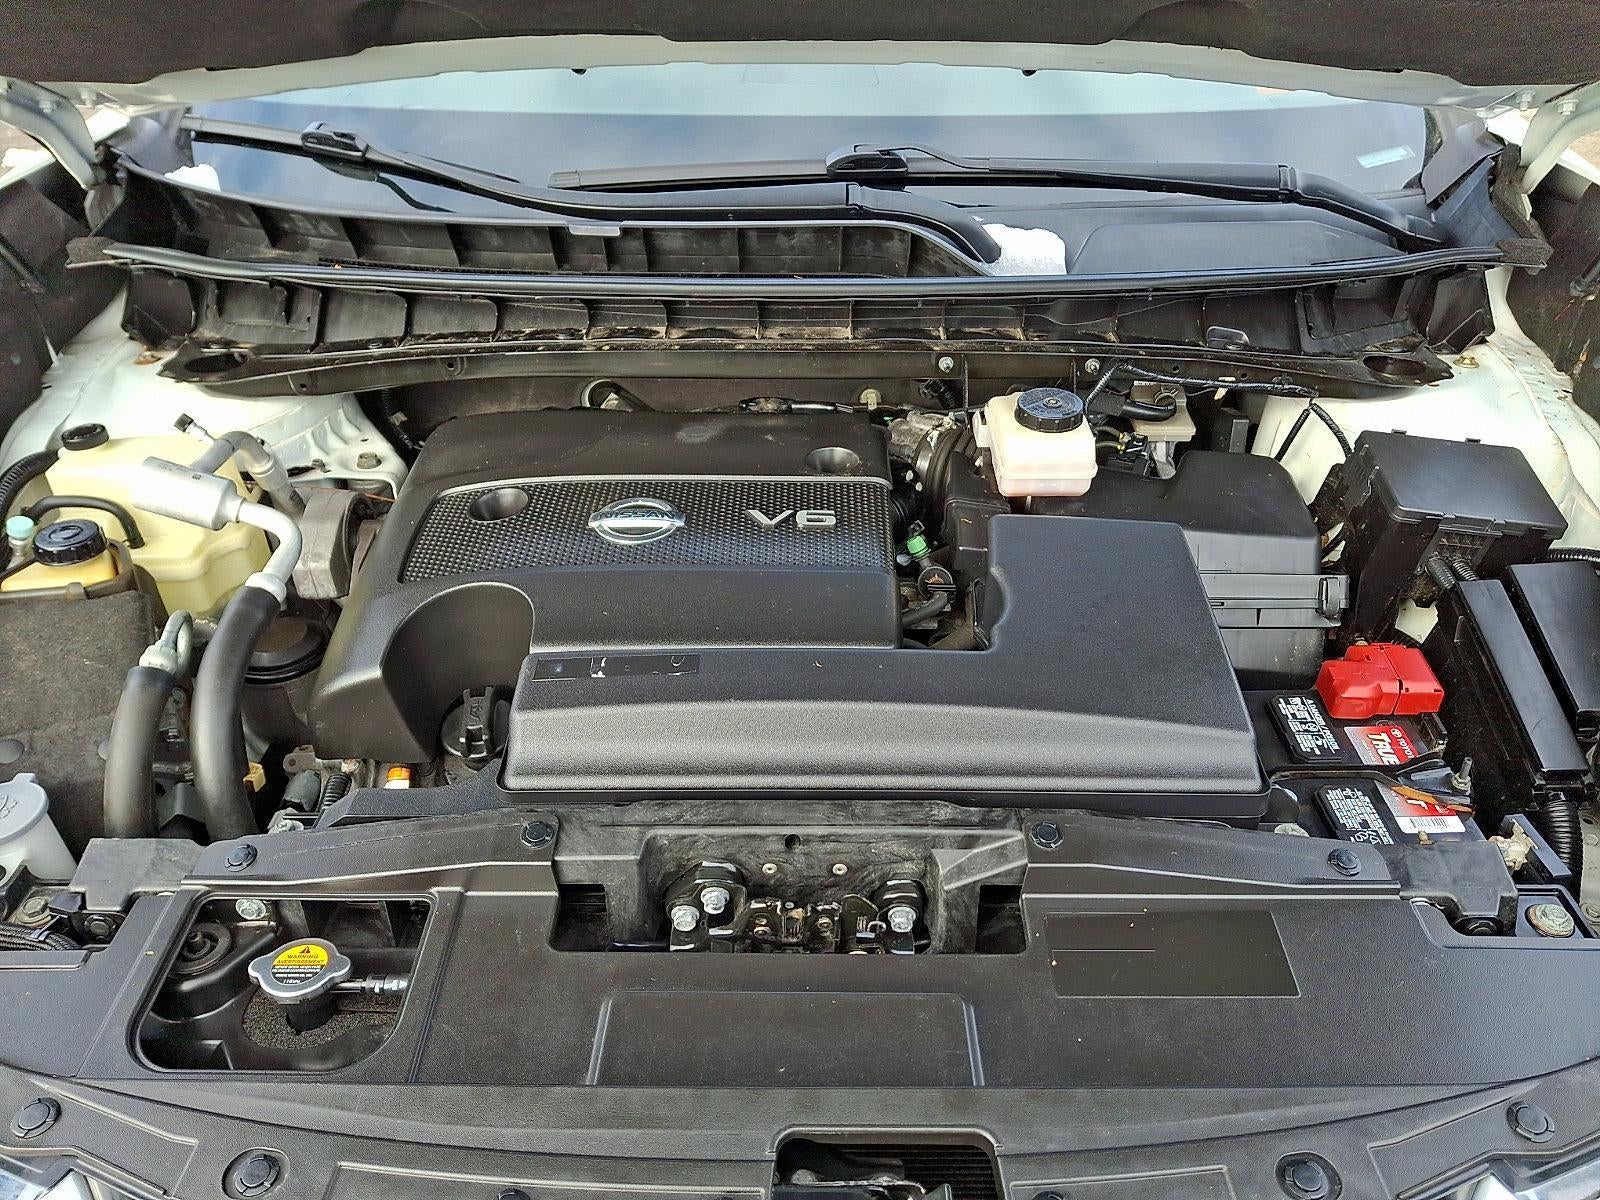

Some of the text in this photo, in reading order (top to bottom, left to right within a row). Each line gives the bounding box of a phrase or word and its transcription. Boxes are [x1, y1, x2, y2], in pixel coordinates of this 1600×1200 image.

[597, 510, 677, 520] NISSAN
[745, 509, 836, 530] V6
[1397, 737, 1415, 759] TOYOT
